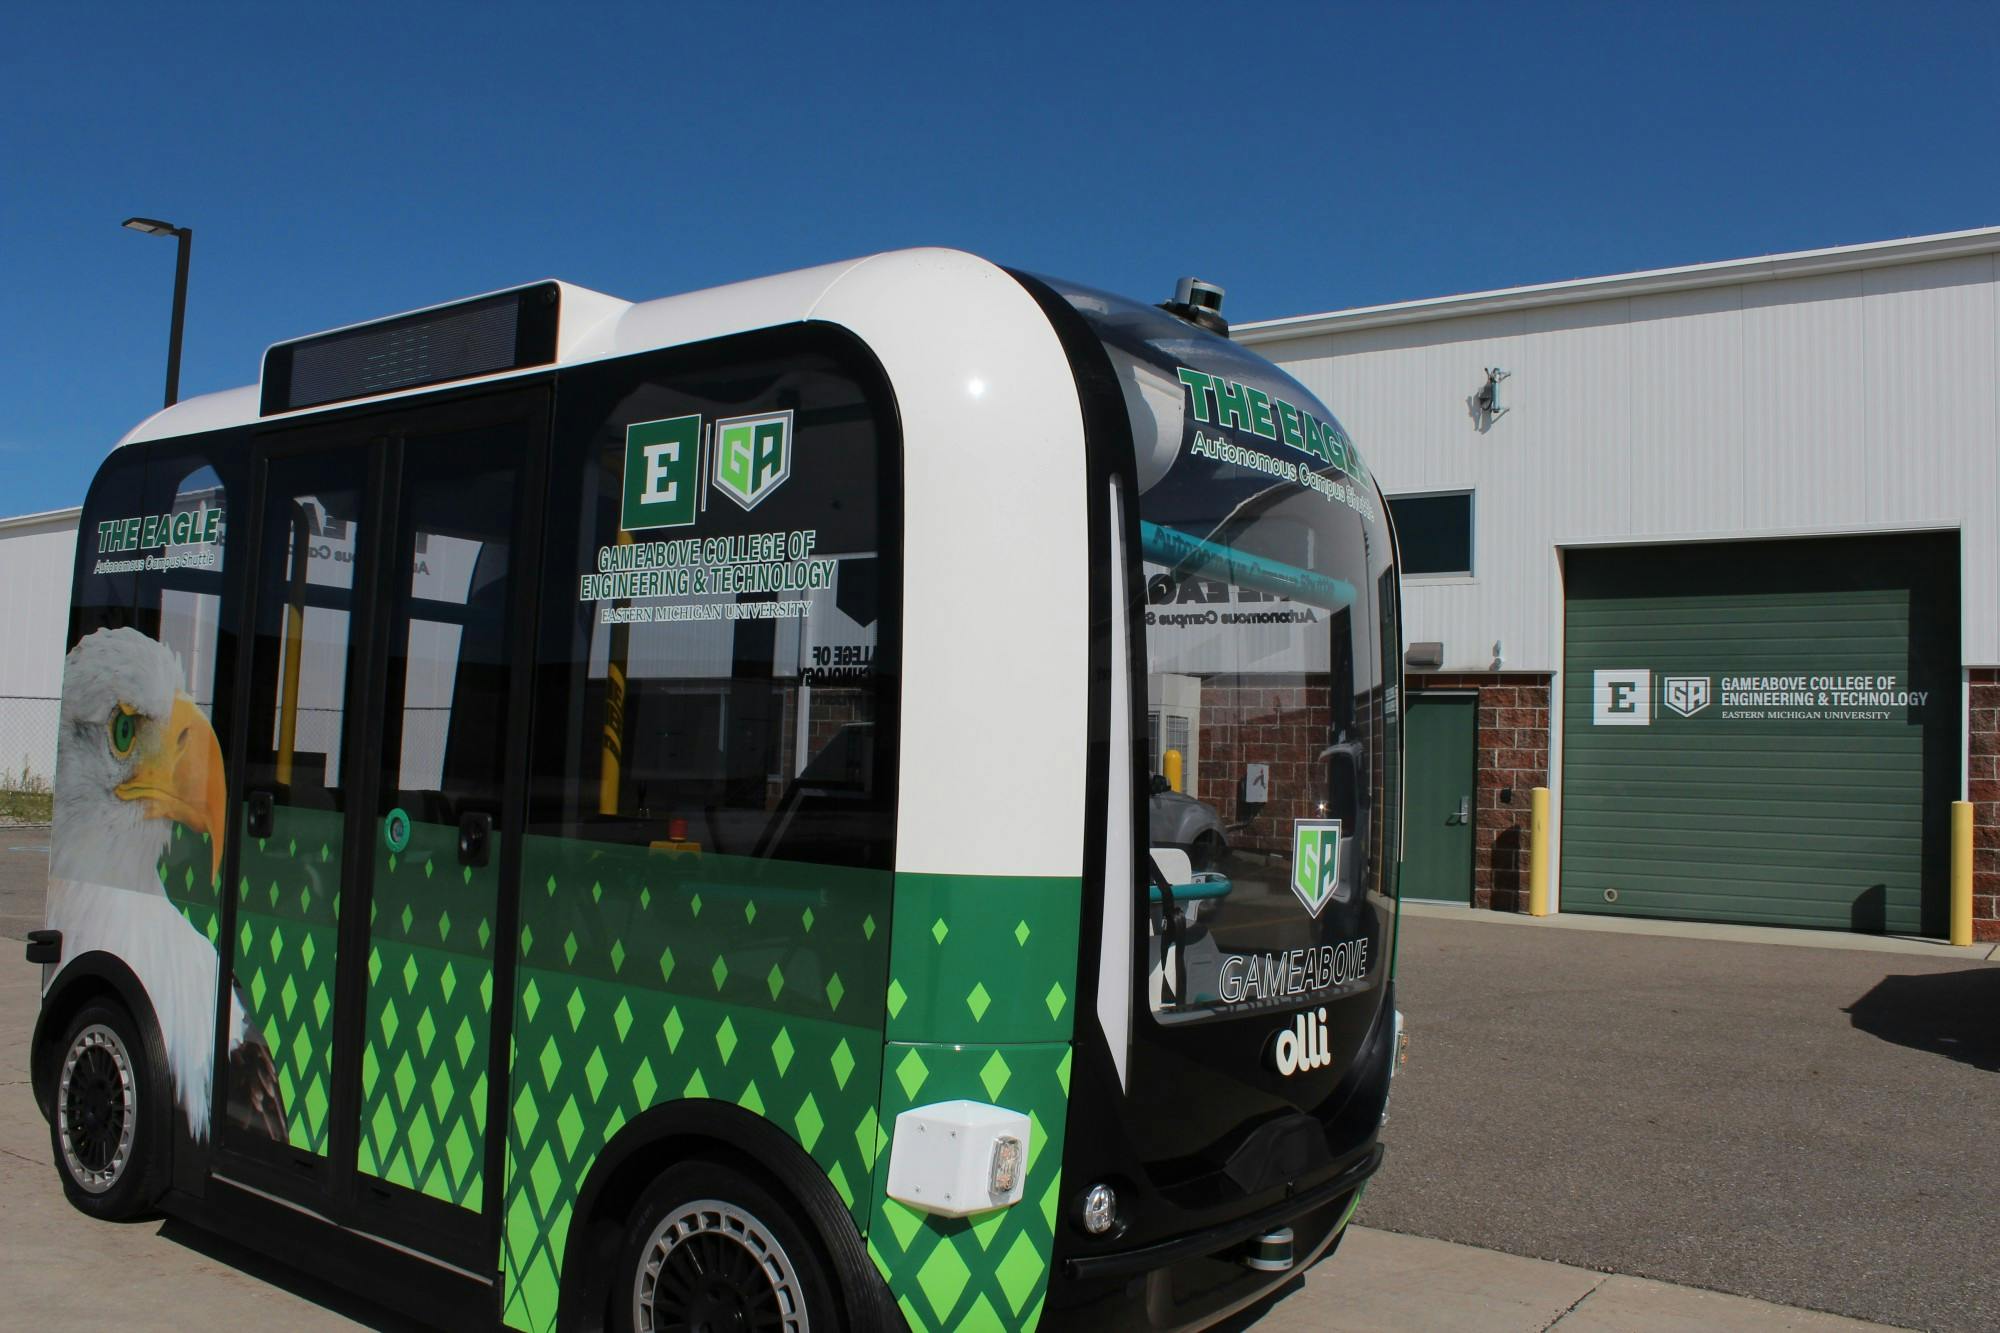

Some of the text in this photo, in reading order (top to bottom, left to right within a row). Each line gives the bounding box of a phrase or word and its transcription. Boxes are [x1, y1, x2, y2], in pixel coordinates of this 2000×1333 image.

[1177, 367, 1277, 440] THE
[640, 441, 680, 504] E
[1191, 431, 1297, 482] Autonomous
[1299, 462, 1345, 502] Campus
[98, 508, 221, 553] THE EAGLE
[598, 530, 816, 572] GAMEABOVE COLLEGE OF
[93, 549, 214, 575] Autonomous Campus Shuttle
[579, 559, 838, 601] ENGINEERING & TECHNOLOGY
[600, 600, 813, 624] EASTERN MICHIGAN UNIVERSITY
[1607, 681, 1636, 713] E
[1721, 676, 1896, 691] GAMEABOVE COLLEGE OF
[1721, 691, 1928, 707] ENGINEERING & TECHNOLOGY
[1722, 710, 1890, 720] EASTERN MICHIGAN UNIVERSITY
[1219, 938, 1368, 1002] GAMEABOVE
[1276, 1007, 1331, 1076] olli
